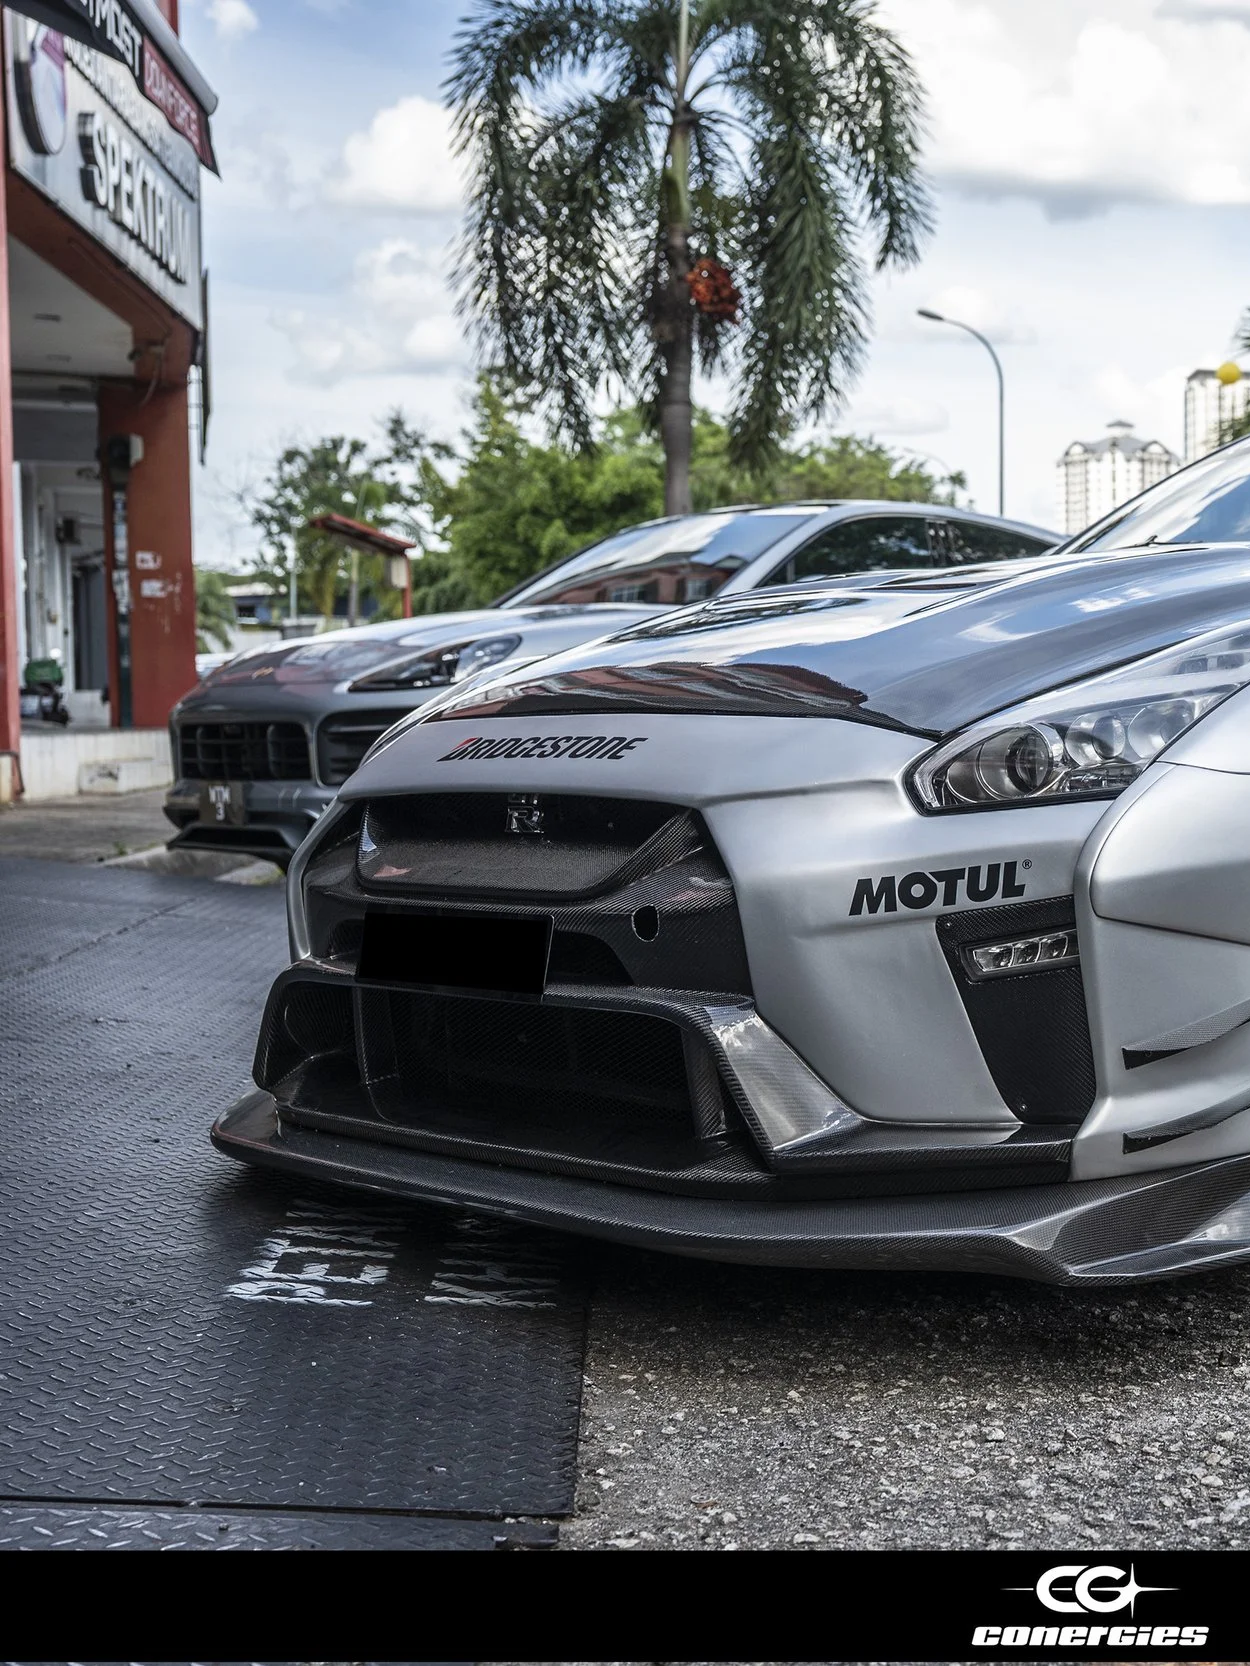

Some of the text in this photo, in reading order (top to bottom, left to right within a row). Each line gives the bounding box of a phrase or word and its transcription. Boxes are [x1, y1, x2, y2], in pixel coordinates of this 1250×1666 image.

[82, 111, 190, 284] SPEKTRUM
[436, 736, 648, 762] BRIDGESTONE
[848, 860, 1026, 916] MOTUL
